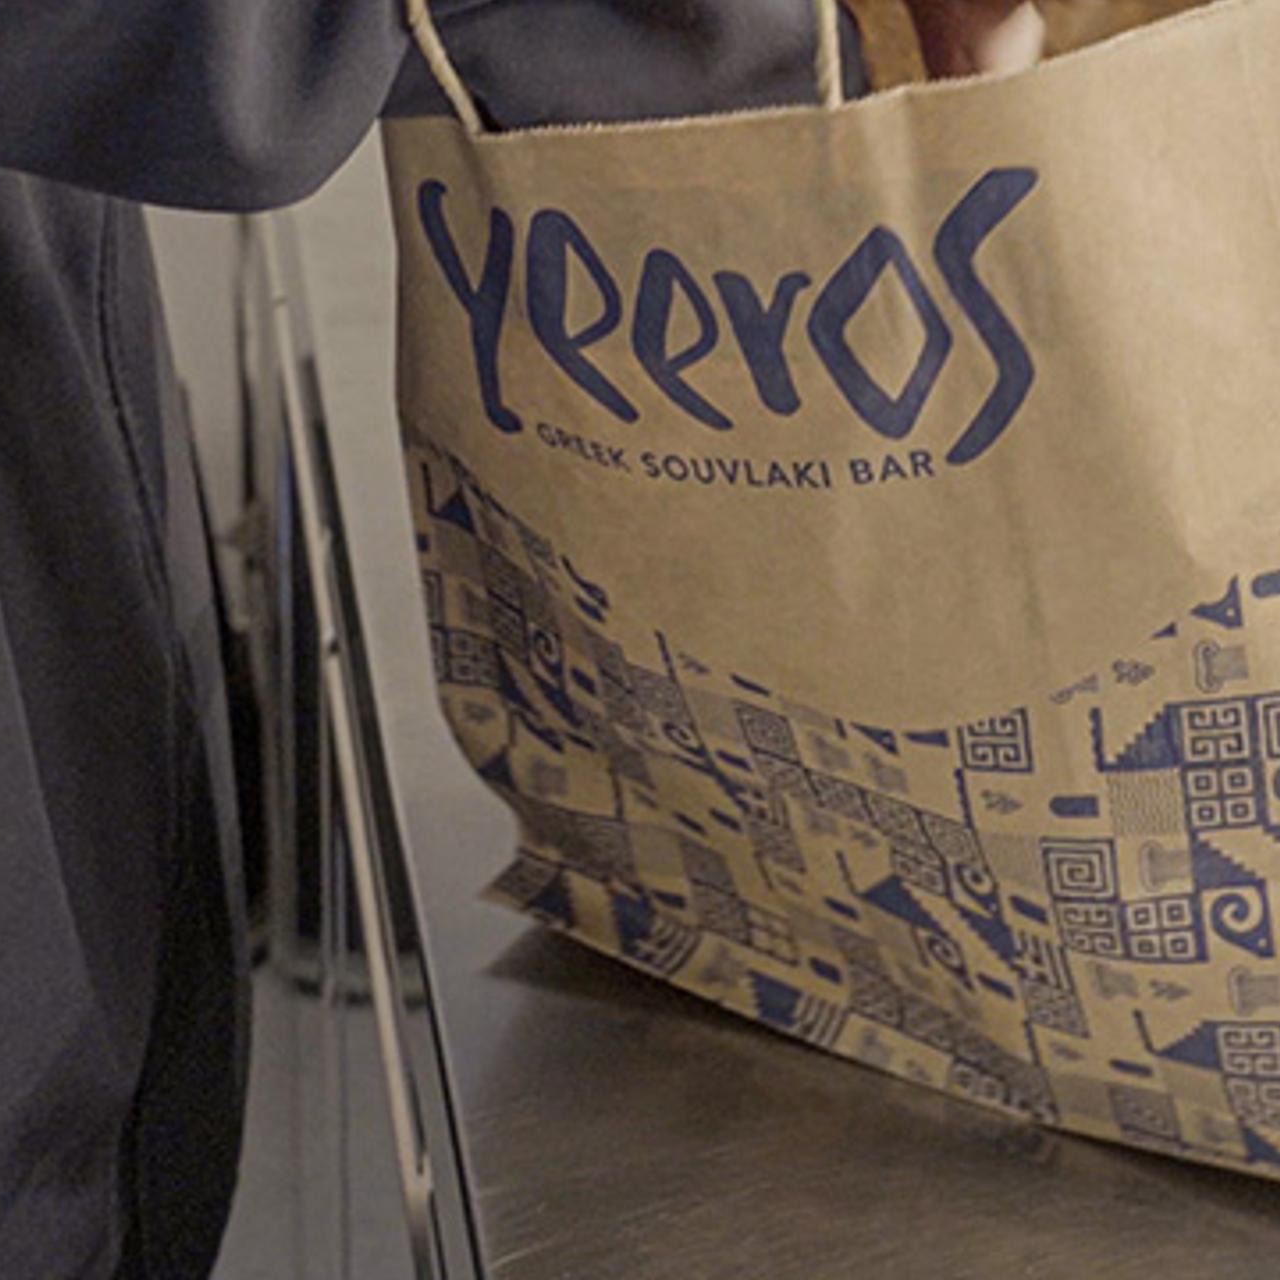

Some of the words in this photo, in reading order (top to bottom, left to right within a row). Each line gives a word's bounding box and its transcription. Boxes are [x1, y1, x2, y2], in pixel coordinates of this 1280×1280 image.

[535, 421, 631, 473] GREEK
[640, 451, 832, 489] SOUVLAKI
[849, 449, 936, 486] BAR
